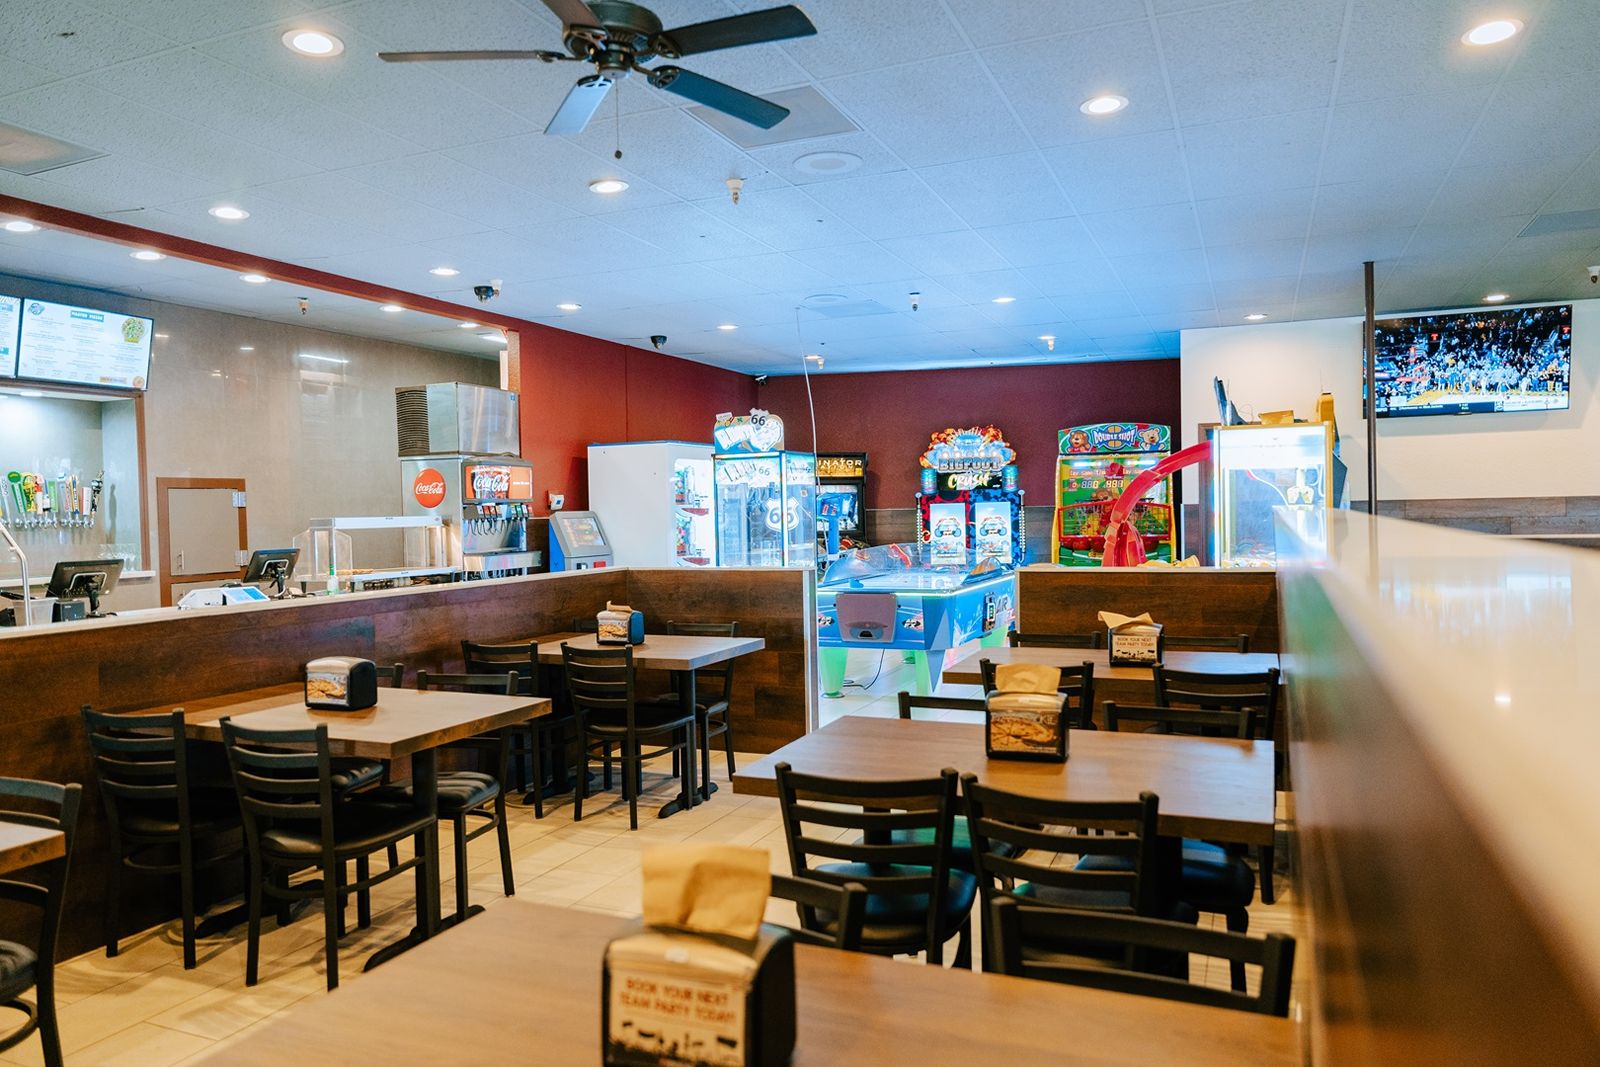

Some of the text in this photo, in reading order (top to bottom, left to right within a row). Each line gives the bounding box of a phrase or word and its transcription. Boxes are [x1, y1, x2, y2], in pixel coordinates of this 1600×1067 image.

[751, 414, 766, 426] 66
[1093, 428, 1136, 445] DOUBLE SHOT
[758, 465, 771, 477] 66
[938, 456, 1001, 471] BIGFOOT
[947, 470, 991, 489] CRUSH
[415, 481, 444, 495] Coca-Cola
[626, 978, 728, 1004] BOOK YOUR NEXT
[620, 992, 649, 1008] TEAM
[655, 1000, 690, 1015] PARTY
